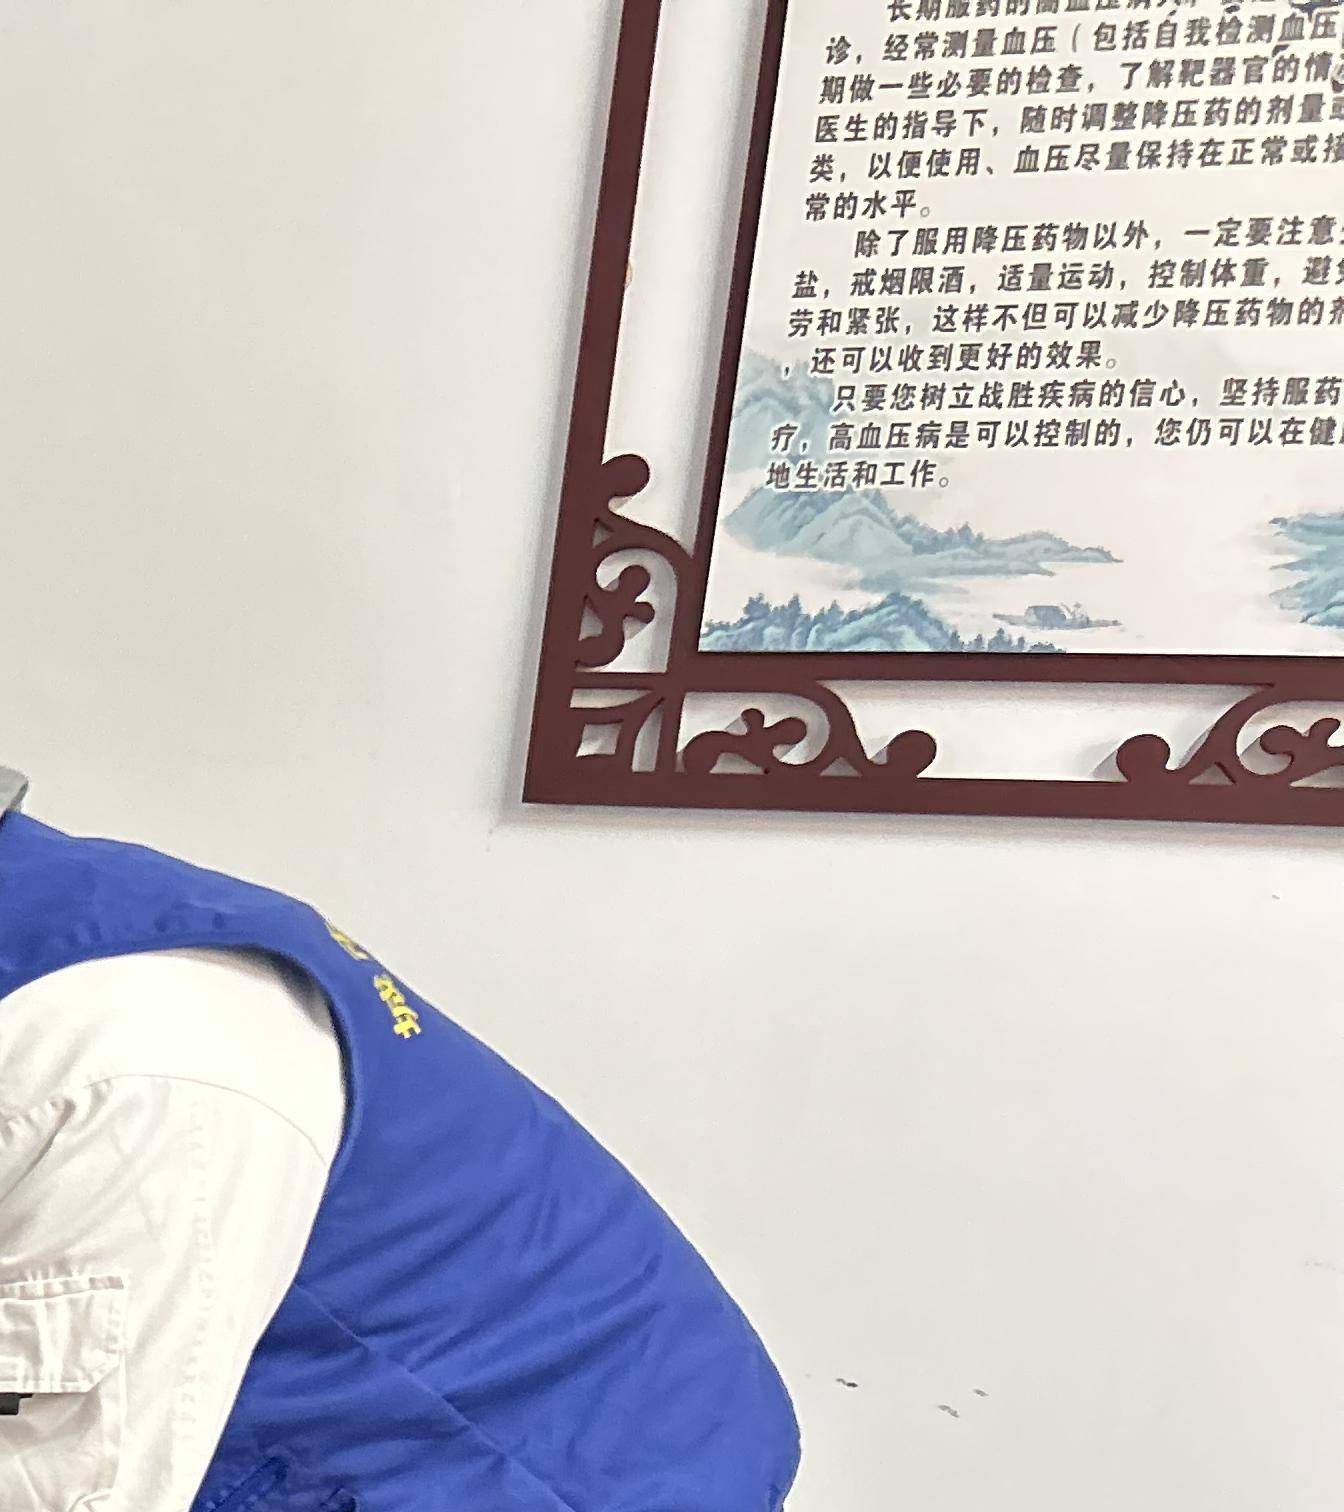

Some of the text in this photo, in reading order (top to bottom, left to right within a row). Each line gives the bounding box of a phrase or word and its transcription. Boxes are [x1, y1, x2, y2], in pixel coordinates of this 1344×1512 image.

[825, 11, 1344, 64] 诊，经常测量血压（包括自我检测血压
[818, 51, 1344, 104] 期做一些必要的检查，了解靶器官的情
[805, 189, 930, 221] 常的水平。
[855, 215, 1344, 258] 除了服用降压药物以外，一定要注意
[771, 416, 1344, 452] 疗，高血压病是可以控制的，您仍可以在健
[766, 460, 949, 489] 地生活和工作。
